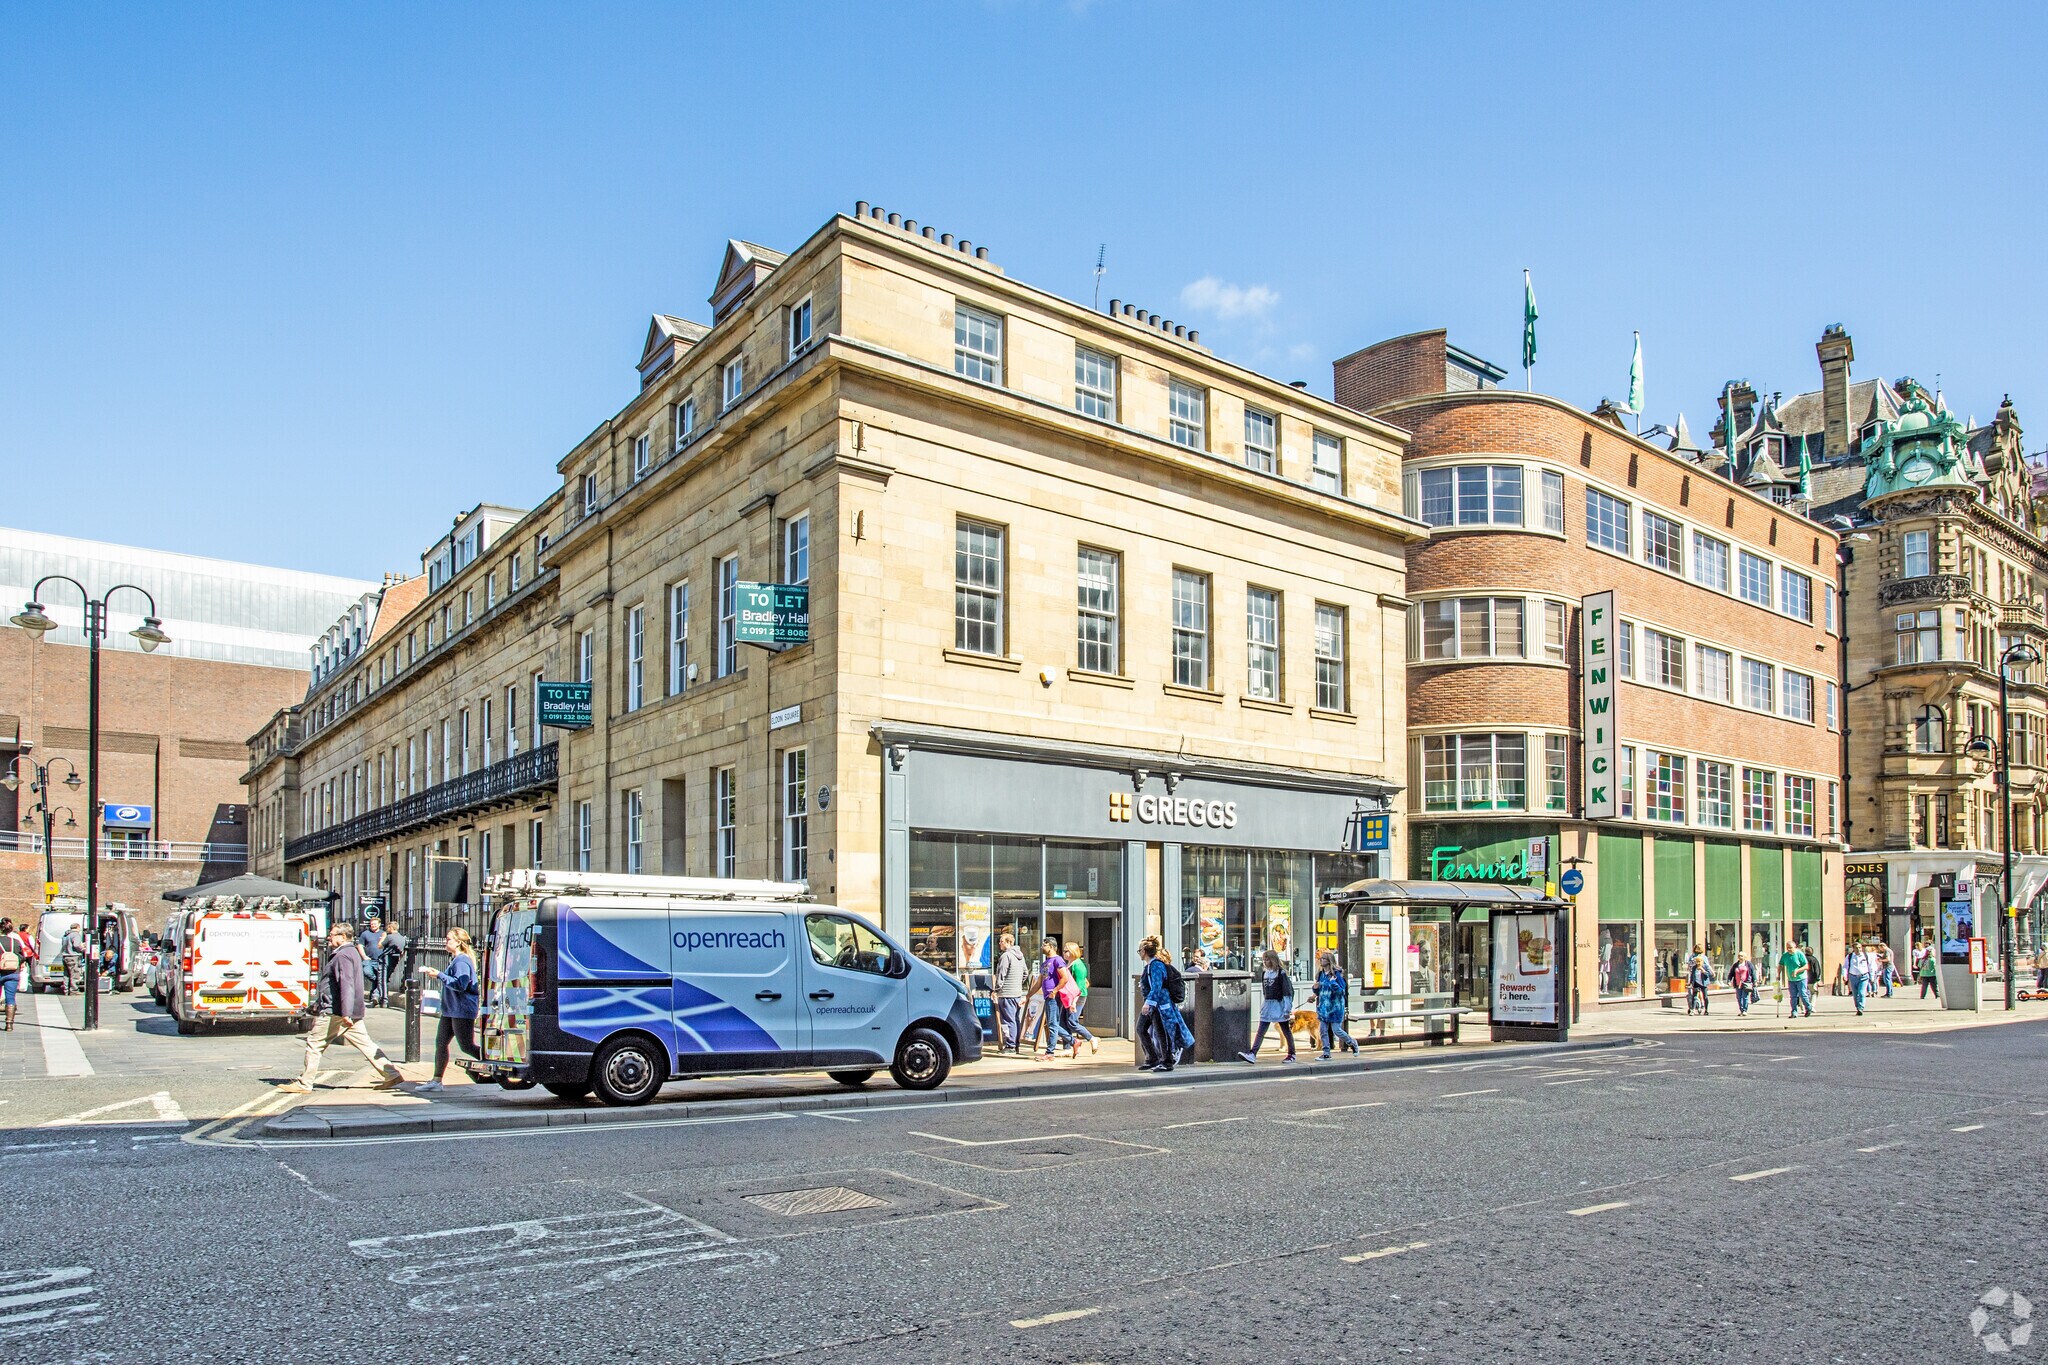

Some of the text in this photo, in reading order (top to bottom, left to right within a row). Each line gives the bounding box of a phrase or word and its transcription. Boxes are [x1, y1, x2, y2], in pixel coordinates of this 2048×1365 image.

[748, 593, 804, 608] TO LET
[742, 610, 785, 626] Bradley
[749, 627, 767, 635] 0191
[769, 628, 785, 636] 232
[548, 690, 589, 700] TO LET
[543, 701, 592, 712] Bradley Hal
[1589, 608, 1609, 804] FENWICK
[1137, 794, 1238, 829] GREGGS
[1941, 874, 1950, 884] W
[209, 929, 250, 938] openreach
[673, 929, 785, 951] openreach
[1500, 983, 1536, 992] Rewards
[1499, 991, 1530, 1001] is here.
[974, 999, 990, 1007] OPEN
[816, 1005, 876, 1014] openreach.co.uk
[976, 1008, 991, 1016] LATE
